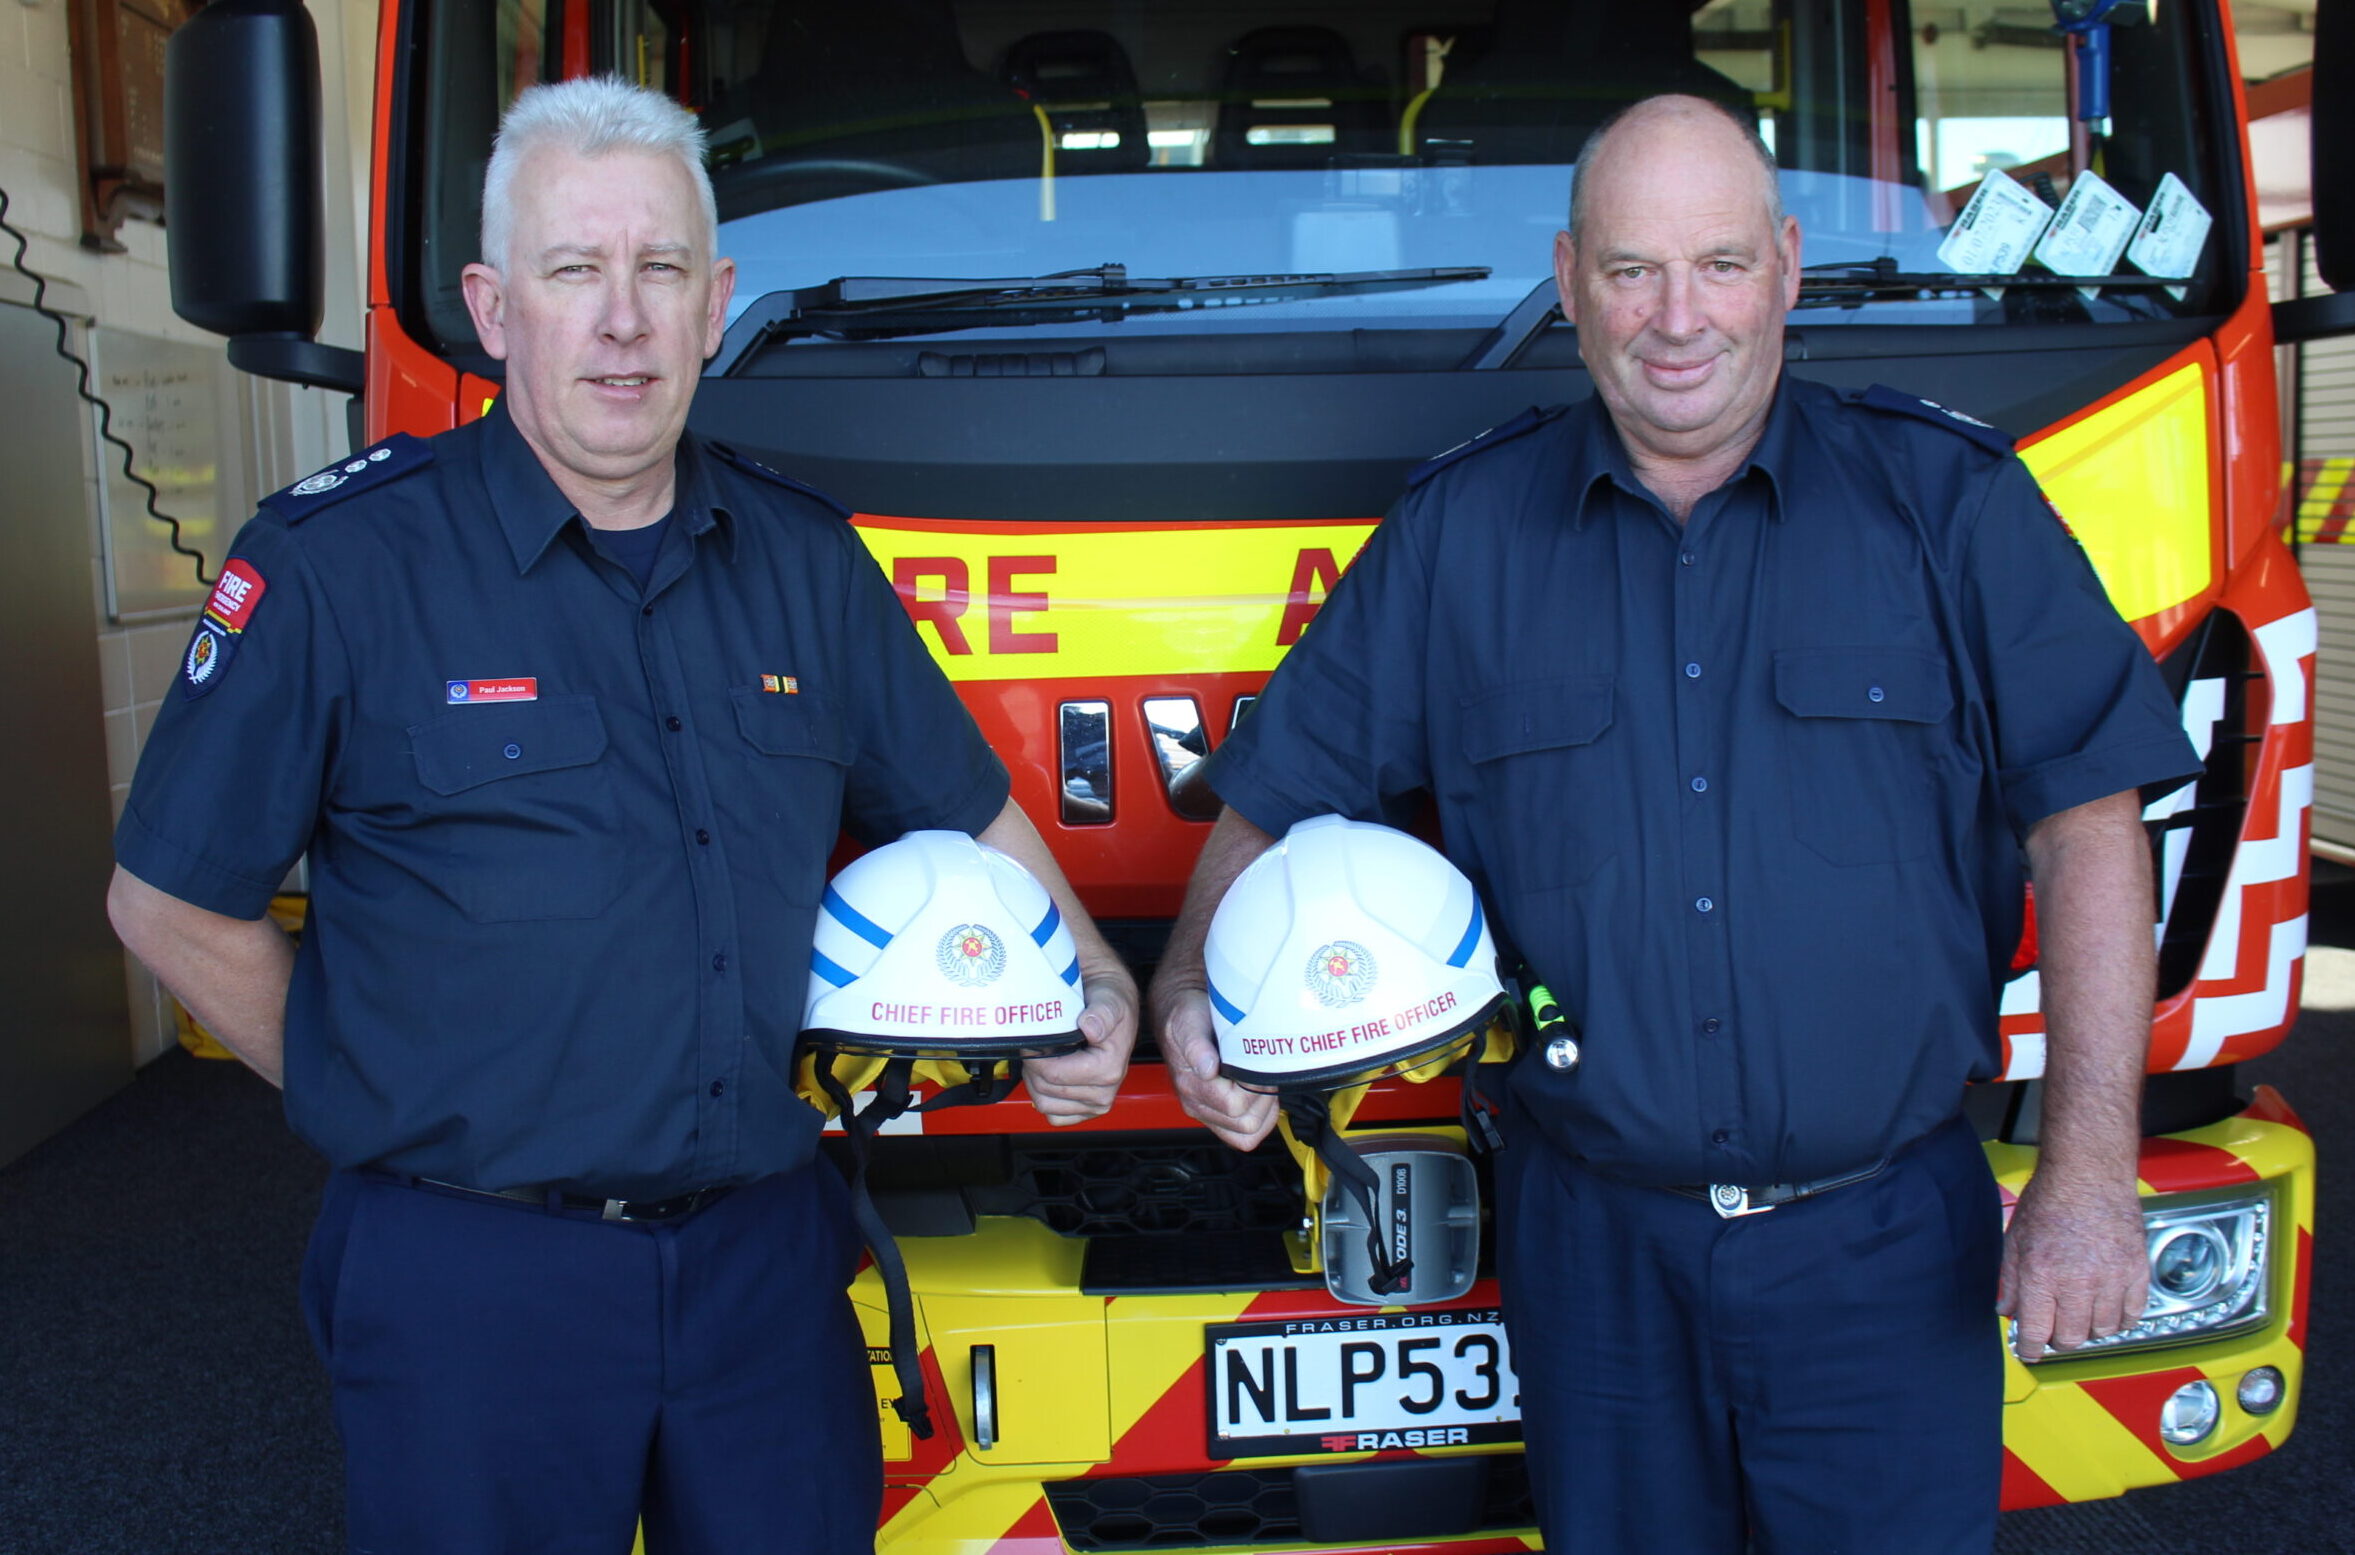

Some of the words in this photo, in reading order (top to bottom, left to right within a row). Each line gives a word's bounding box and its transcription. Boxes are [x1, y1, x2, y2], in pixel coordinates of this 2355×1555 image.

[219, 570, 253, 603] FIRE
[496, 685, 527, 693] Jackson
[871, 1002, 933, 1025] CHIEF
[939, 1007, 987, 1026] FIRE
[994, 1001, 1063, 1025] OFFICER
[1242, 1038, 1295, 1056] DEPUTY
[1300, 1030, 1349, 1054] CHIEF
[1351, 1018, 1392, 1044] FIRE
[1393, 991, 1458, 1031] OFFICER
[1396, 1223, 1407, 1263] ODE
[1285, 1311, 1499, 1335] FRASER.ORG.NZ
[867, 1350, 892, 1362] ATIO
[1226, 1333, 1521, 1425] NLP53
